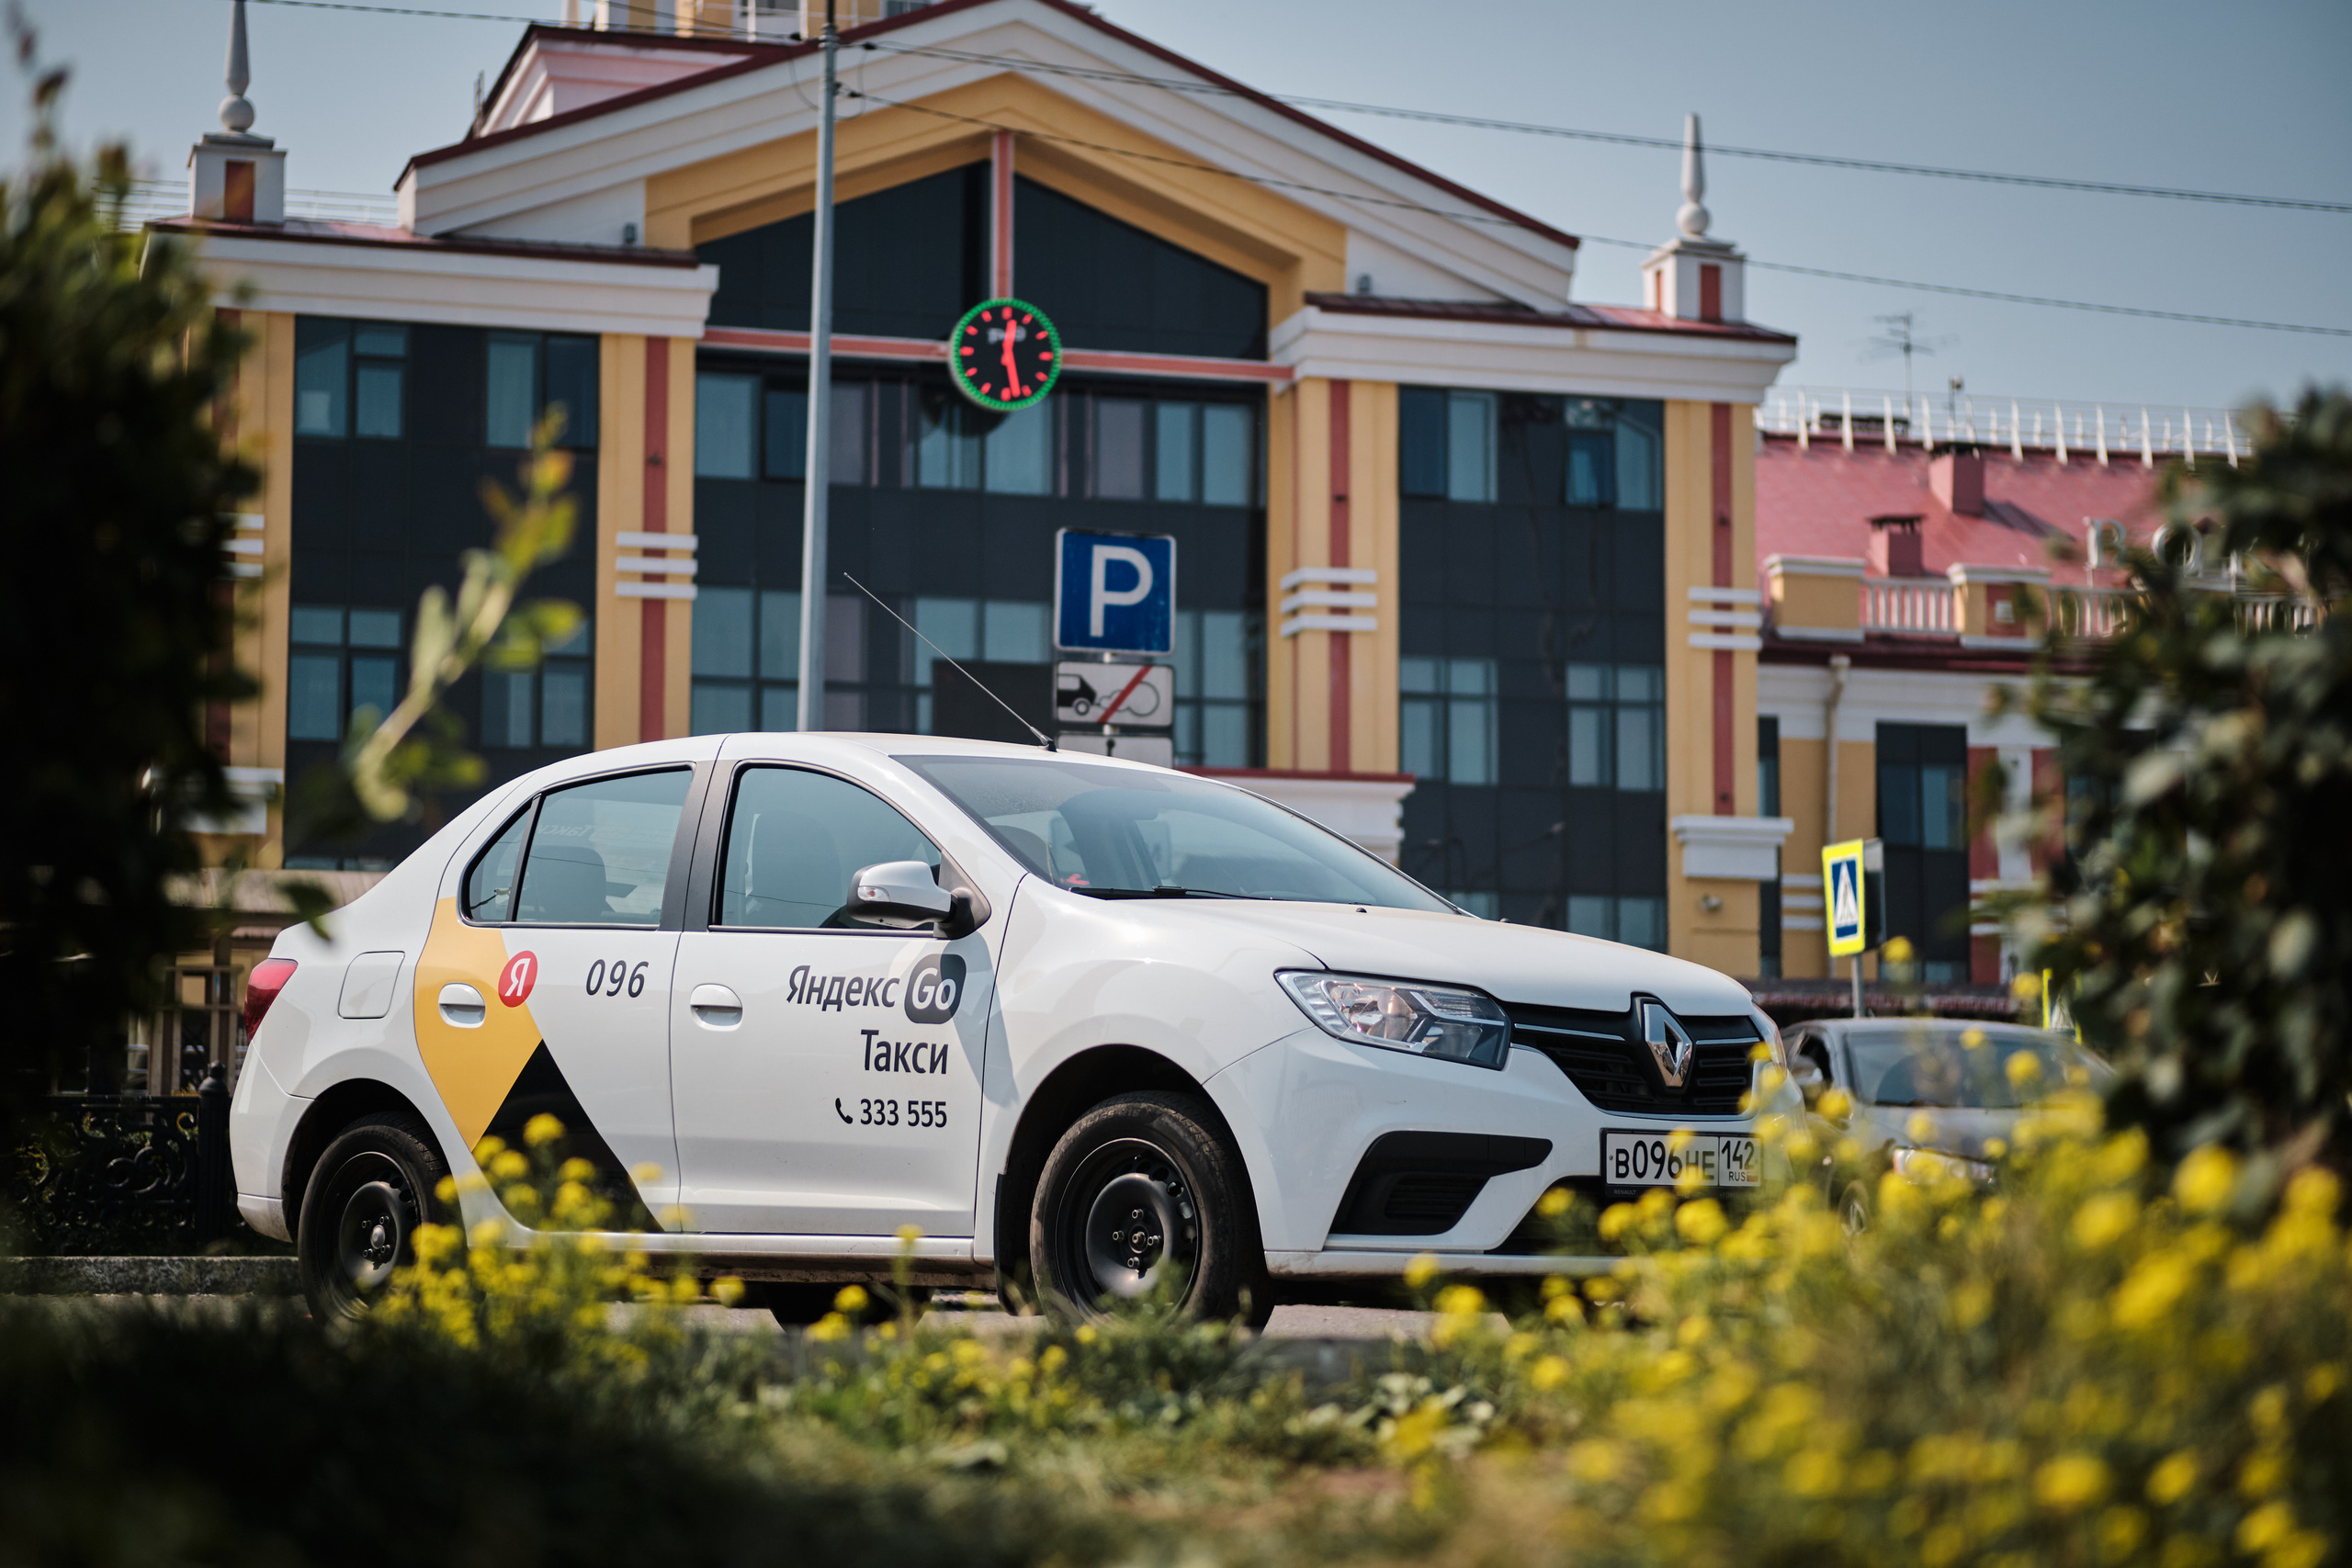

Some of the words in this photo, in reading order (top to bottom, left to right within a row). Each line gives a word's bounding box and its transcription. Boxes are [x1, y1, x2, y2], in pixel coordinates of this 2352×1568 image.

[1090, 544, 1153, 637] P
[504, 957, 531, 997] Я
[585, 958, 650, 998] 096
[786, 964, 900, 1012] Яндекс
[911, 966, 956, 1010] Go
[860, 1029, 949, 1075] Такси
[860, 1098, 899, 1126] 333
[907, 1100, 948, 1128] 555
[1721, 1140, 1755, 1170] 142
[1728, 1171, 1746, 1182] RUS
